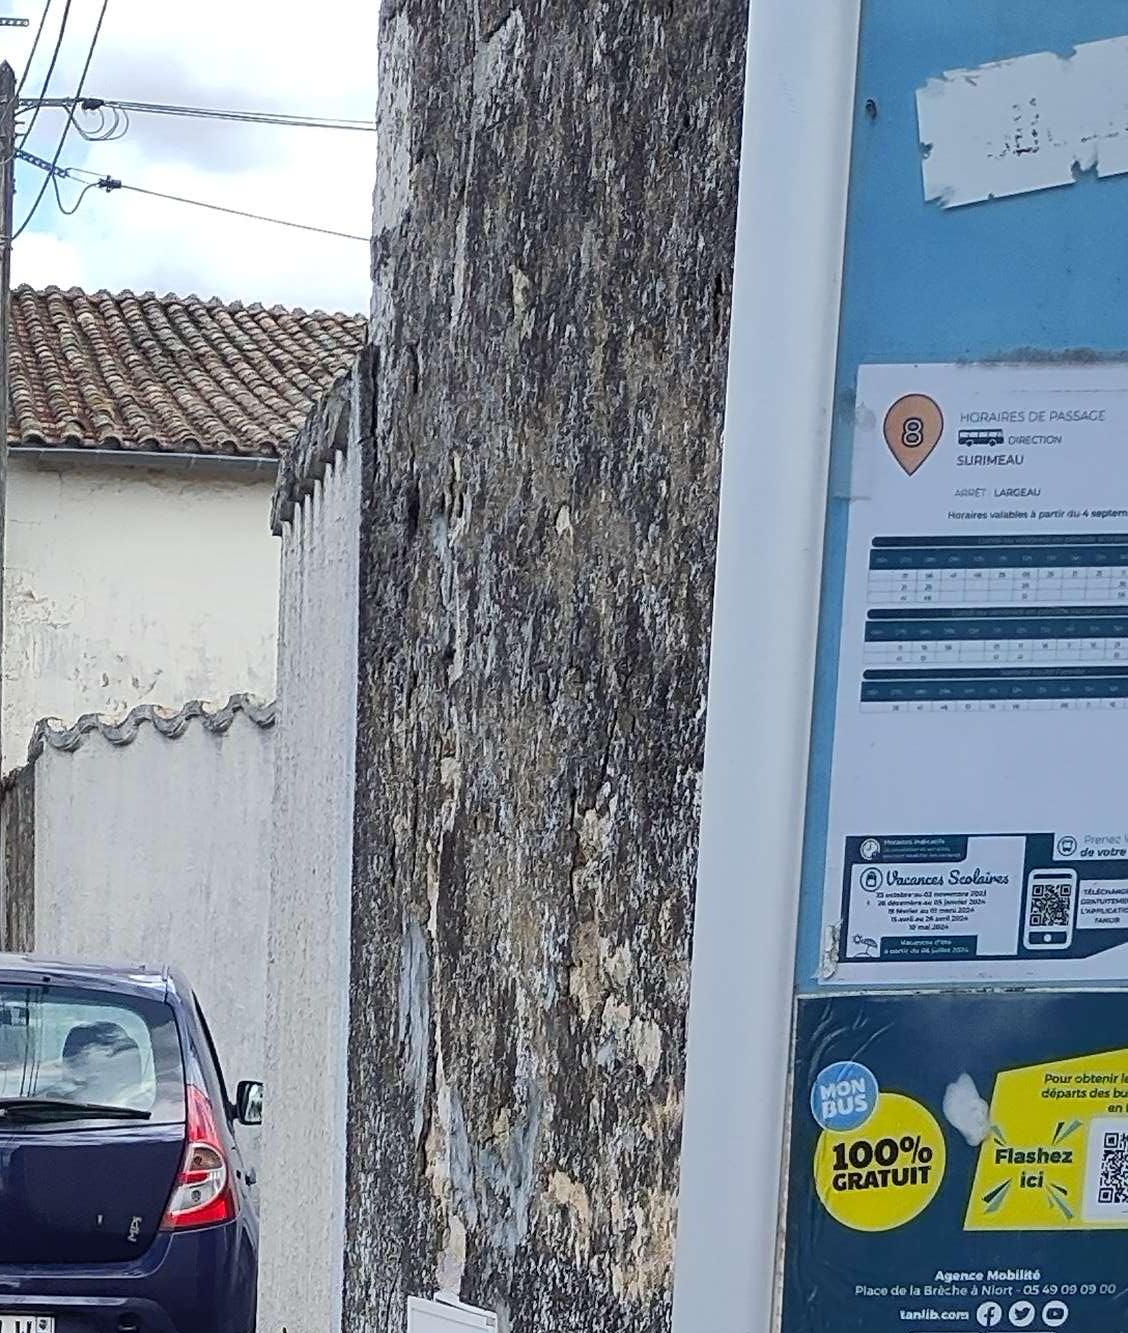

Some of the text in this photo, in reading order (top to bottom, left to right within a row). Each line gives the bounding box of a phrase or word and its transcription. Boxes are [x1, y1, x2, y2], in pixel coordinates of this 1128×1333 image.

[960, 409, 1107, 423] HORAIRES DE PASSAGE
[901, 417, 925, 448] 8
[1008, 435, 1063, 445] DIRECTION
[956, 455, 1025, 466] SURIMEAU
[993, 487, 1042, 497] LARGEAU
[947, 510, 988, 520] Horaires
[989, 510, 1028, 519] valables
[1038, 509, 1066, 520] partir
[1080, 847, 1127, 857] de votre
[886, 867, 1010, 887] Vacances Scolaires
[1044, 1073, 1072, 1084] Pour
[1074, 1072, 1119, 1084] obtenir
[821, 1078, 867, 1100] MON
[1041, 1087, 1088, 1100] départs
[1089, 1087, 1111, 1098] des
[822, 1095, 868, 1119] BUS
[1107, 1104, 1123, 1113] en
[832, 1135, 934, 1171] 100%
[994, 1148, 1073, 1165] Flashez
[831, 1165, 932, 1192] GRATUIT
[1020, 1171, 1044, 1189] ici
[934, 1269, 1041, 1284] Agence Mobilité
[854, 1285, 888, 1297] Place
[890, 1285, 906, 1297] de
[909, 1285, 921, 1297] la
[924, 1284, 967, 1297] Brèche
[970, 1284, 979, 1297] à
[981, 1284, 1014, 1297] Niort
[1023, 1284, 1040, 1296] 05
[1042, 1284, 1059, 1296] 49
[1060, 1284, 1078, 1296] 09
[1079, 1284, 1097, 1296] 09
[1099, 1284, 1117, 1295] 00
[899, 1309, 970, 1322] tanlib.com
